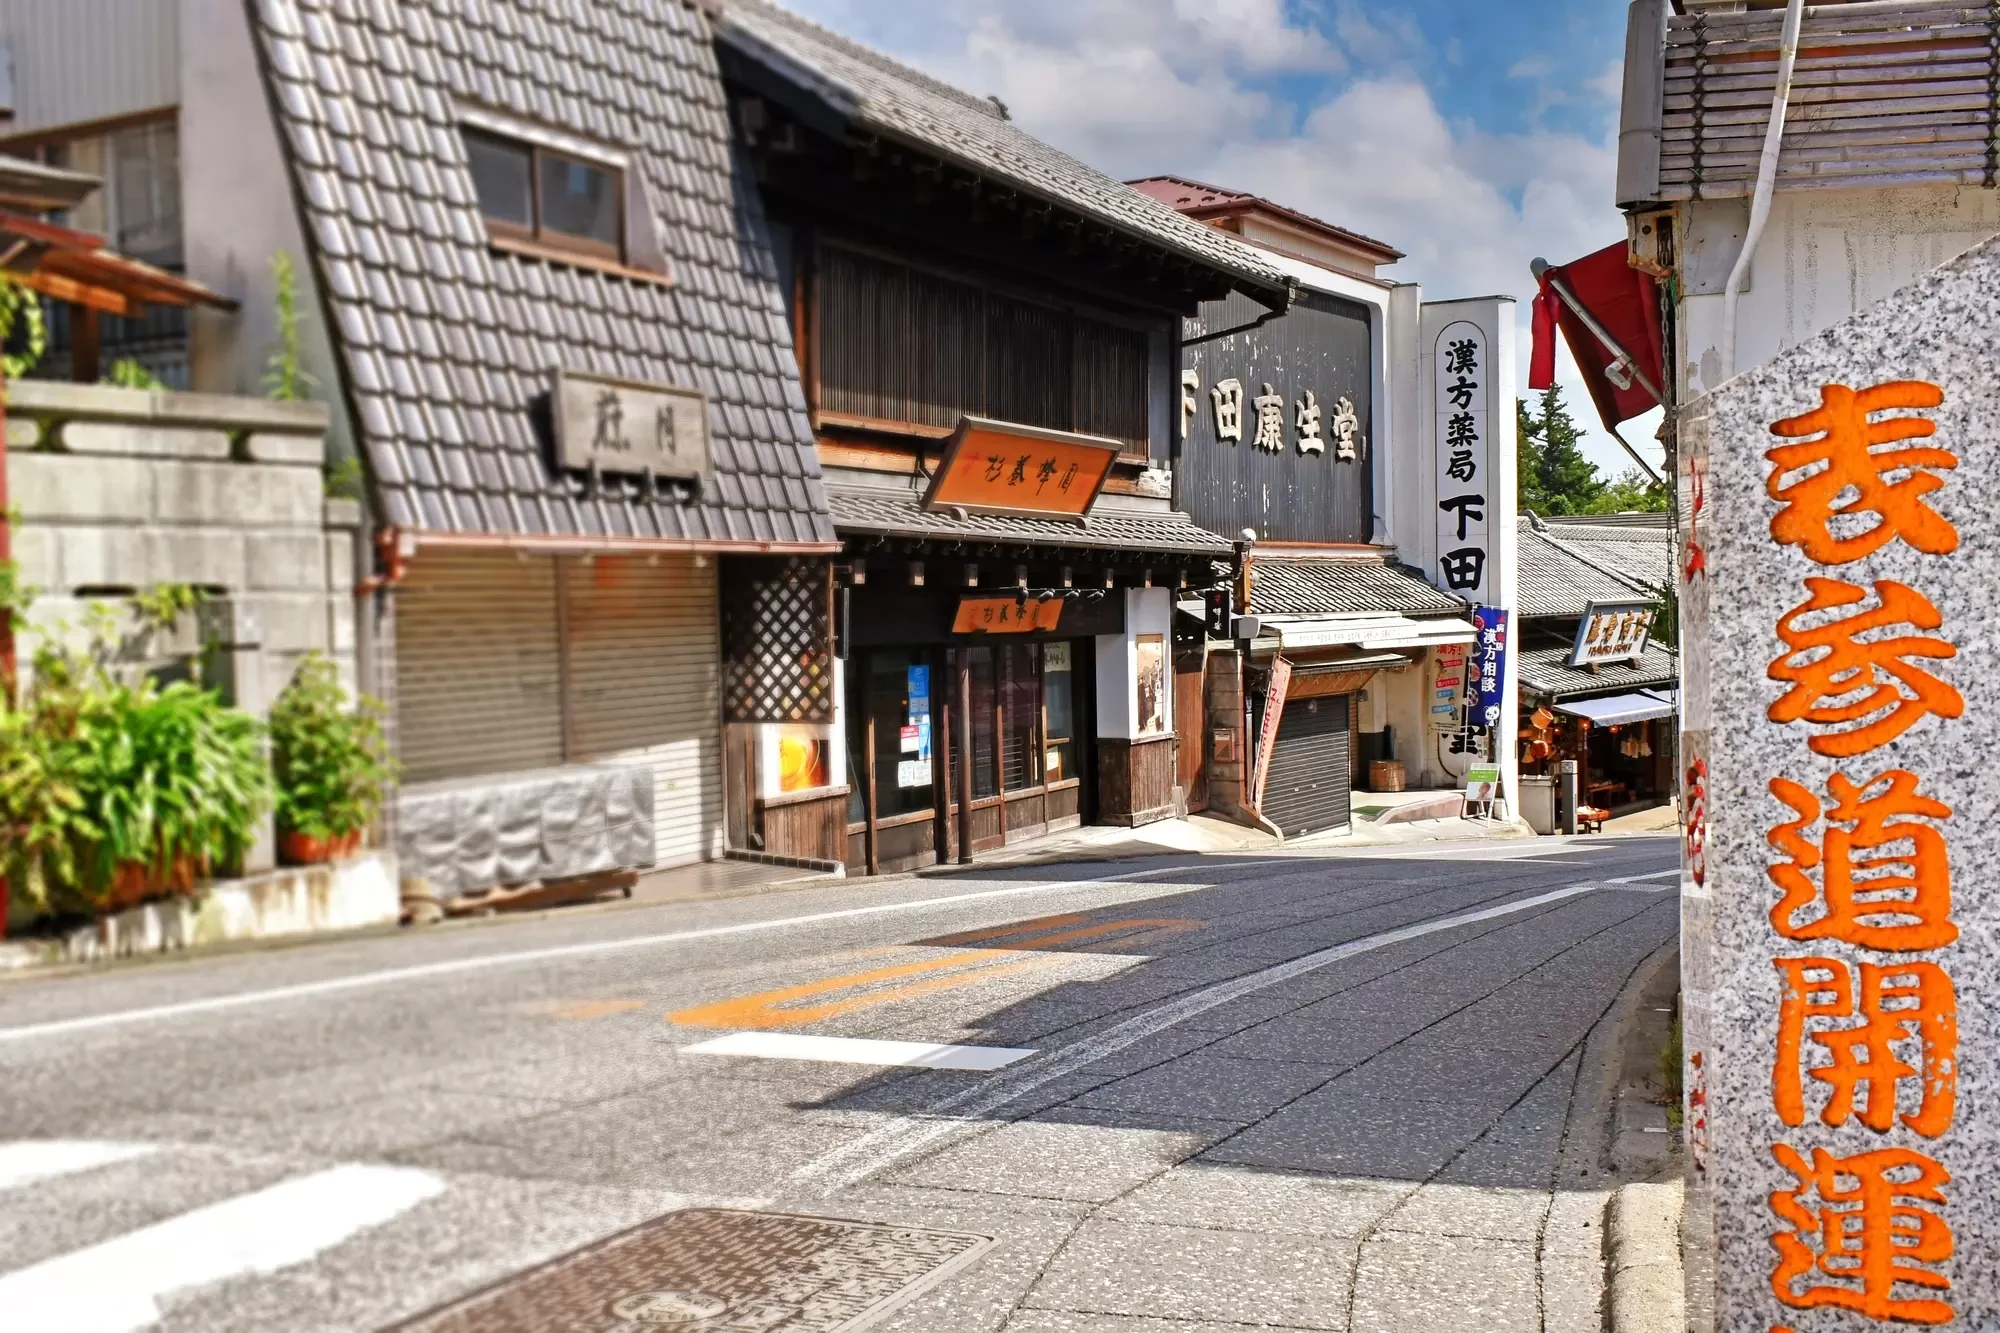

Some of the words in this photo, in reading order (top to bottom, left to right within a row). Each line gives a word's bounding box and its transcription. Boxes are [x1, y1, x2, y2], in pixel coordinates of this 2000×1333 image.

[1445, 339, 1479, 483] 漢方薬局
[1481, 628, 1497, 693] 漢方相談
[1765, 380, 1965, 1333] 表参道開運
